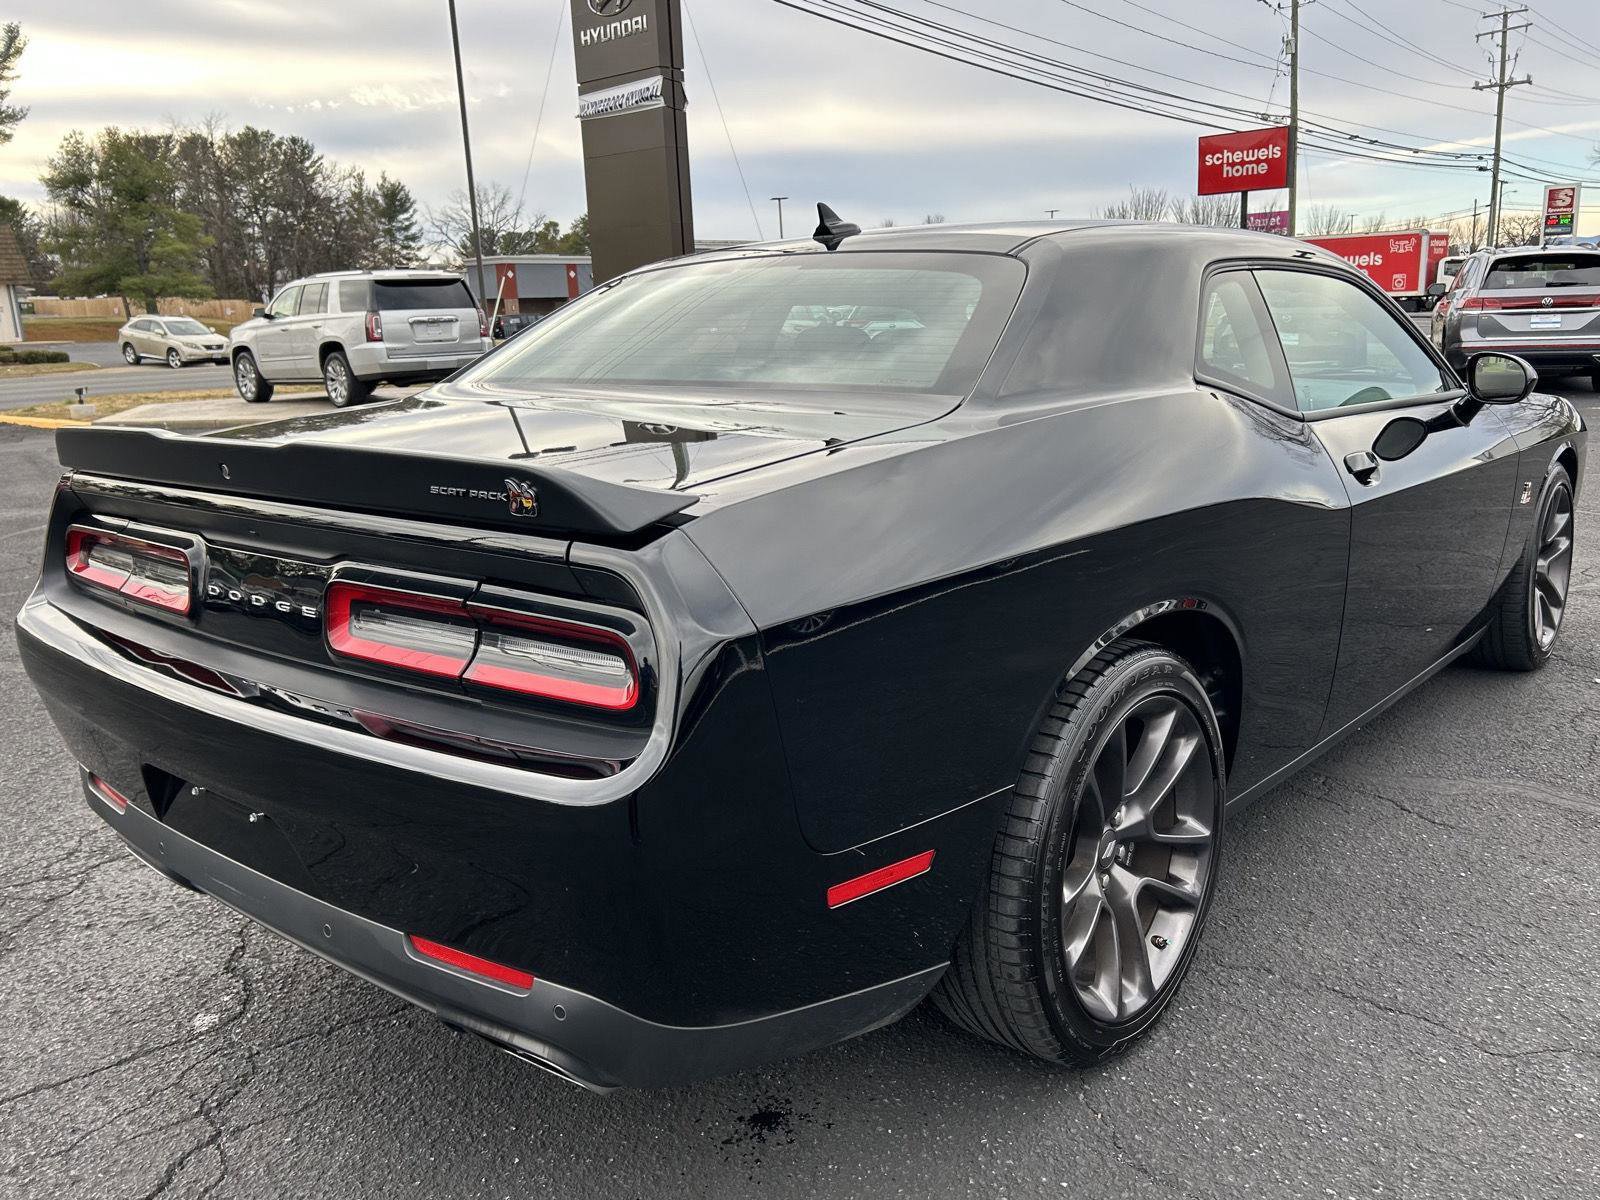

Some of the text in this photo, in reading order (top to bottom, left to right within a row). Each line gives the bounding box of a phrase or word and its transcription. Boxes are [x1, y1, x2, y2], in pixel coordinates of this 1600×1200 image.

[580, 14, 647, 46] HYUNDAI
[1205, 144, 1281, 166] schewels
[1223, 162, 1268, 178] home
[1344, 252, 1383, 266] wels
[430, 485, 507, 502] SCAT PACK
[208, 584, 317, 618] DODGE
